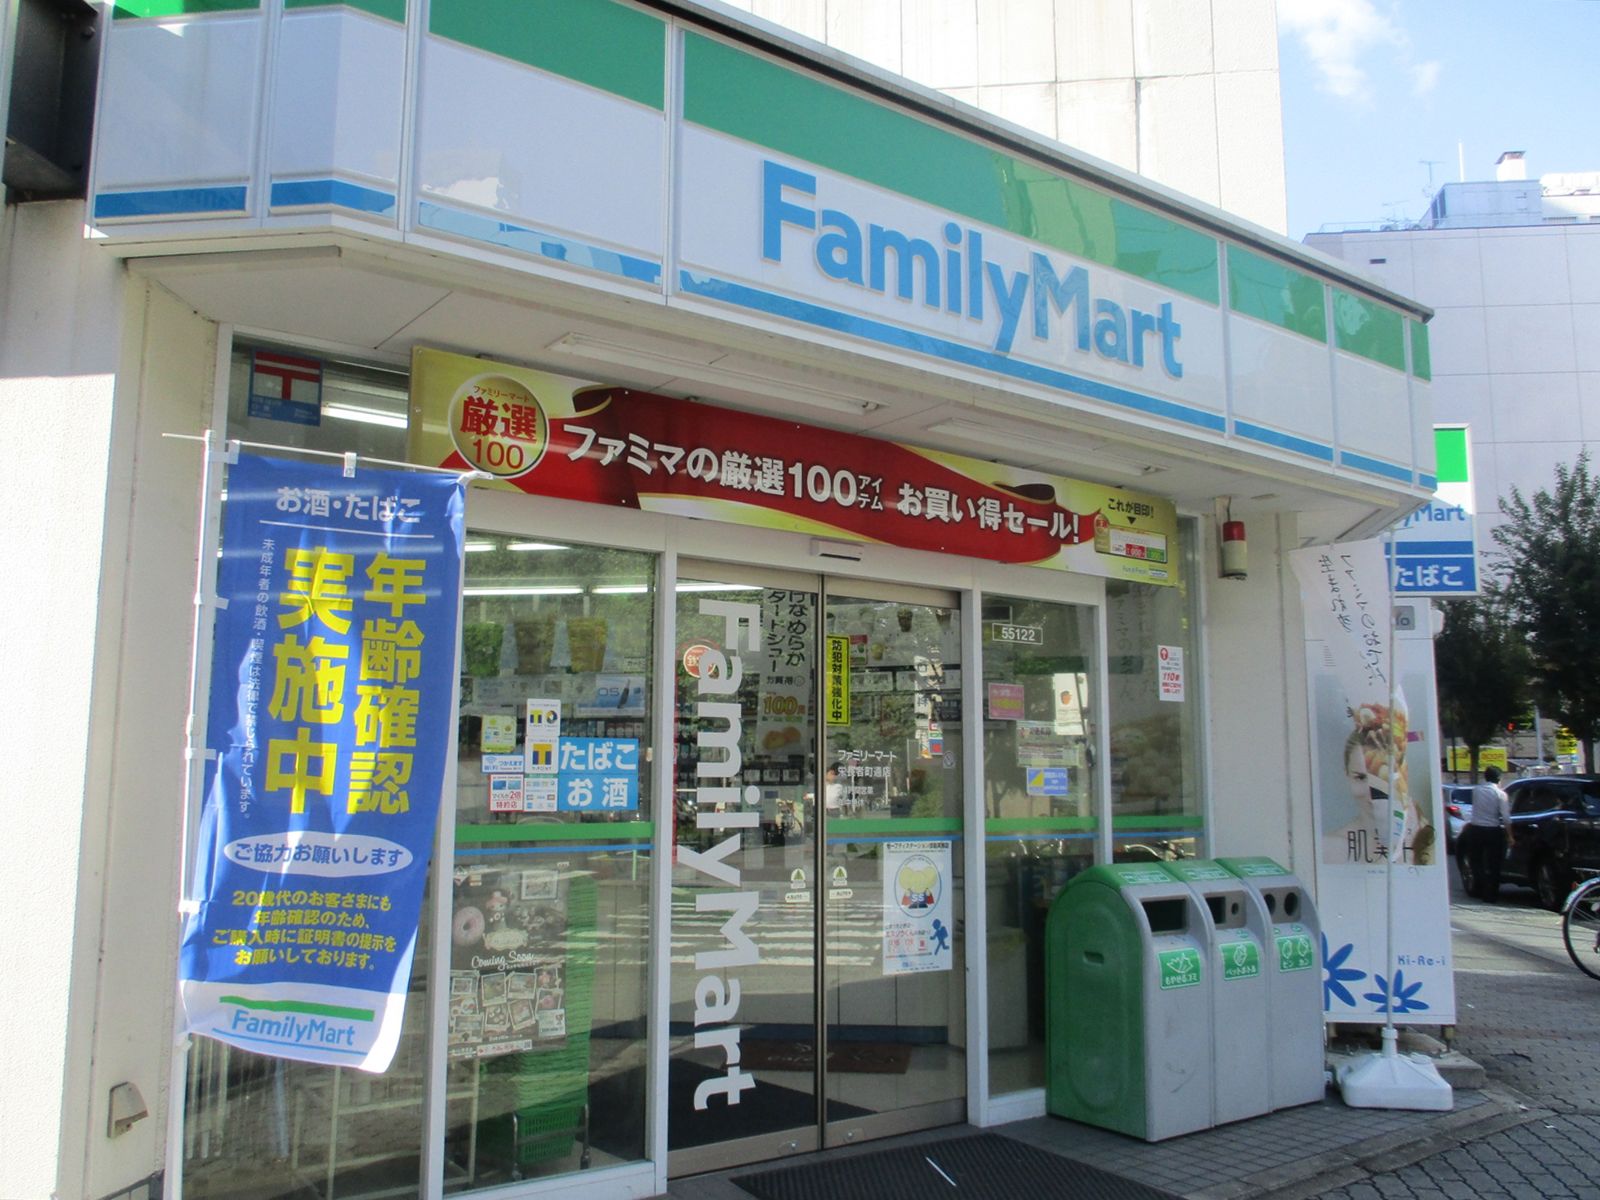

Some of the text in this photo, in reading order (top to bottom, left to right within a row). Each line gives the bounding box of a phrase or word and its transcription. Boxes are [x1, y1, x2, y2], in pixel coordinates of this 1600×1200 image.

[761, 159, 1184, 379] FamilyMart
[473, 385, 530, 403] ファミリーマート
[460, 396, 538, 444] 厳選
[472, 438, 525, 470] 100
[276, 486, 421, 523] お酒・たばこ
[1107, 497, 1155, 519] これが目印!
[1001, 627, 1036, 641] 55122
[264, 546, 355, 814] 実施中
[347, 551, 427, 814] 年齢確認
[831, 639, 843, 720] 防犯対策強化中
[560, 742, 637, 771] たばこ
[837, 749, 898, 763] ファミリーマート
[568, 777, 629, 807] お酒
[234, 842, 404, 867] ご協力お願いします
[677, 598, 761, 1110] FamilyMart
[232, 890, 392, 911] 20歳代のお客さまにも
[253, 910, 370, 929] 年齢確認のため、
[212, 928, 397, 953] ご購入時に証明書の提示を
[234, 949, 375, 972] お願いしております。
[471, 955, 505, 970] Coming
[508, 950, 535, 964] Soon
[1397, 955, 1447, 967] Ki-Re-i
[231, 1009, 355, 1046] FamilyMart
